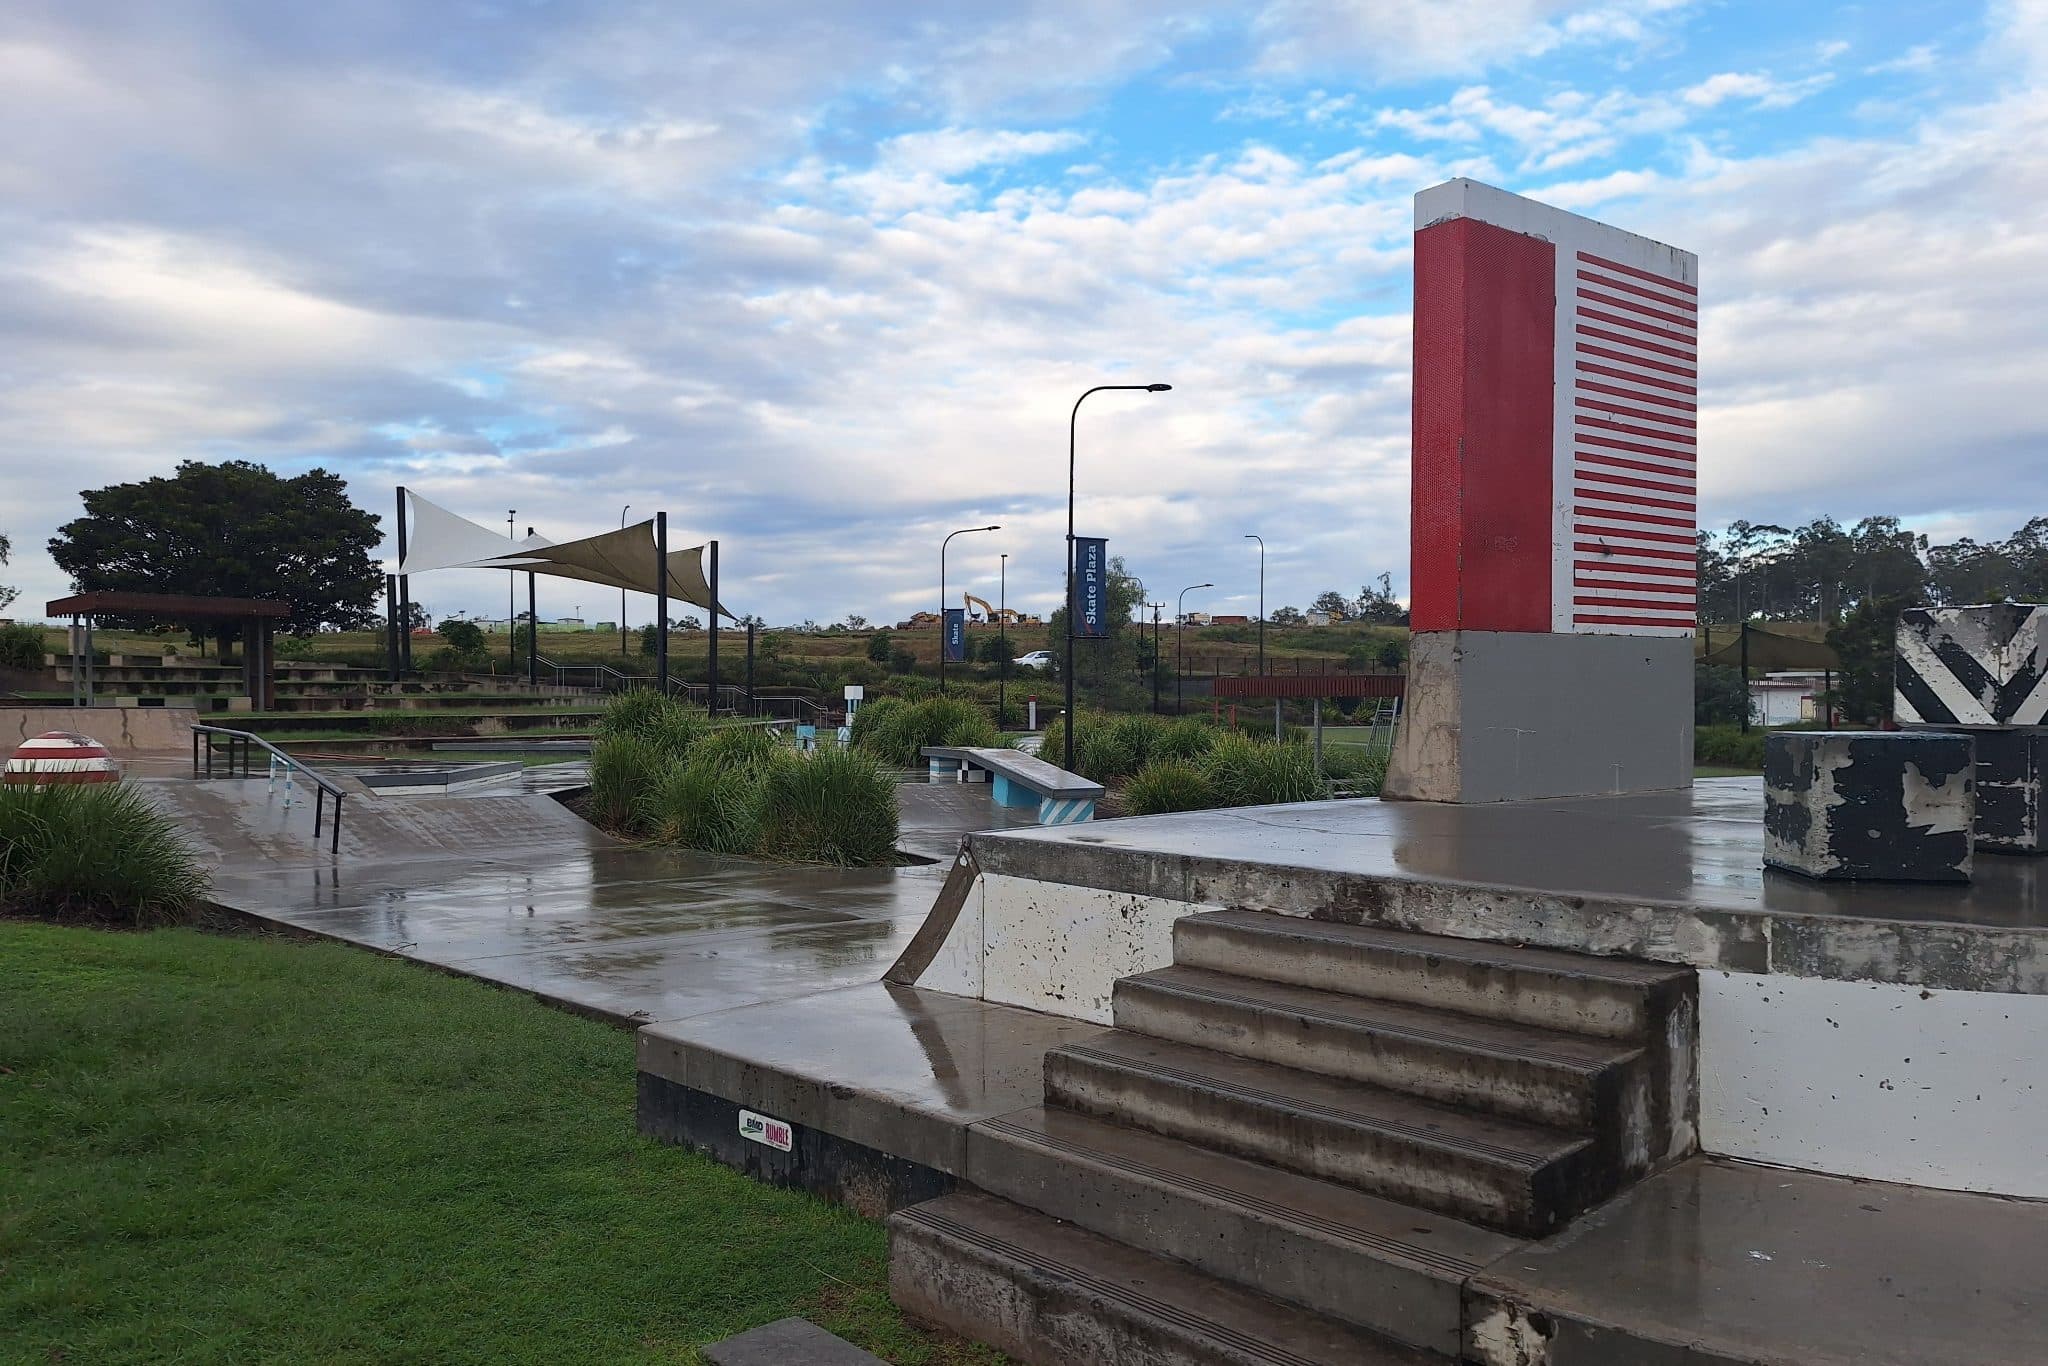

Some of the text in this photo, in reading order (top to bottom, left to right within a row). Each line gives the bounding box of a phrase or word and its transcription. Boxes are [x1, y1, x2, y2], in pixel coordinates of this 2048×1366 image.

[1086, 545, 1097, 625] Skate Plaza
[766, 1122, 789, 1146] RUMBLE
